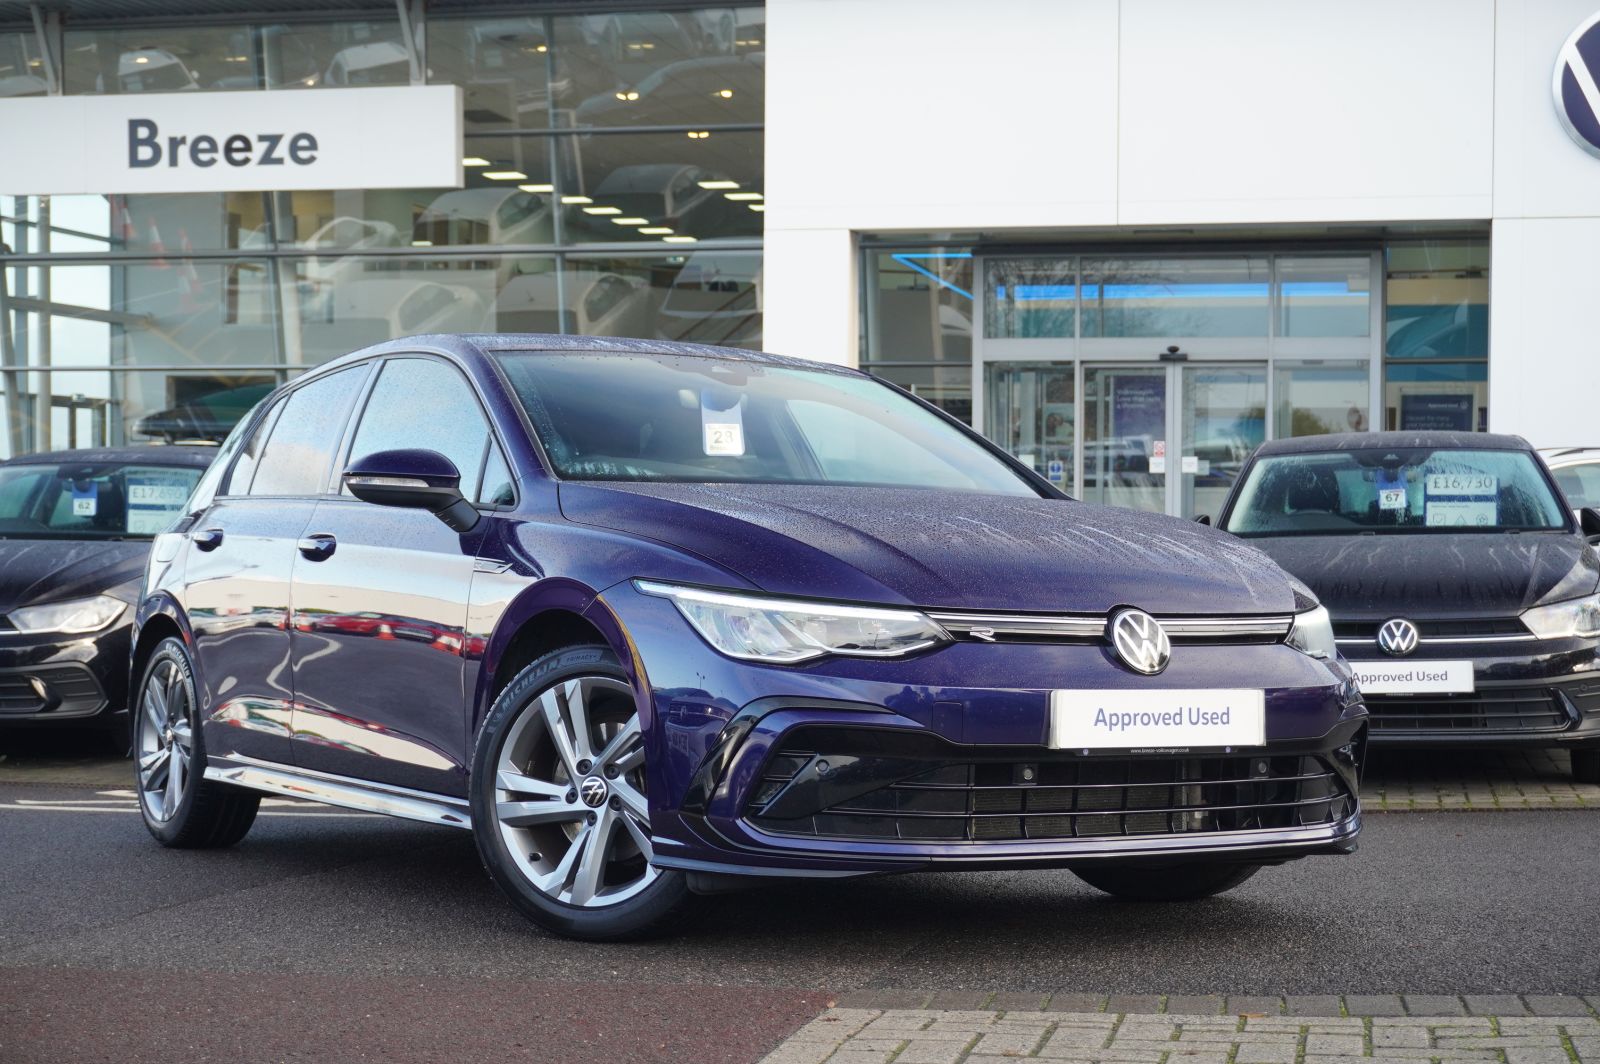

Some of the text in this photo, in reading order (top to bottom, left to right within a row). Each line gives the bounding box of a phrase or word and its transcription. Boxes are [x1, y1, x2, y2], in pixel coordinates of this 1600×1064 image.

[128, 118, 319, 168] Breeze
[1385, 493, 1400, 502] 67
[1352, 670, 1448, 684] Approved Used
[1094, 706, 1230, 731] Approved Used
